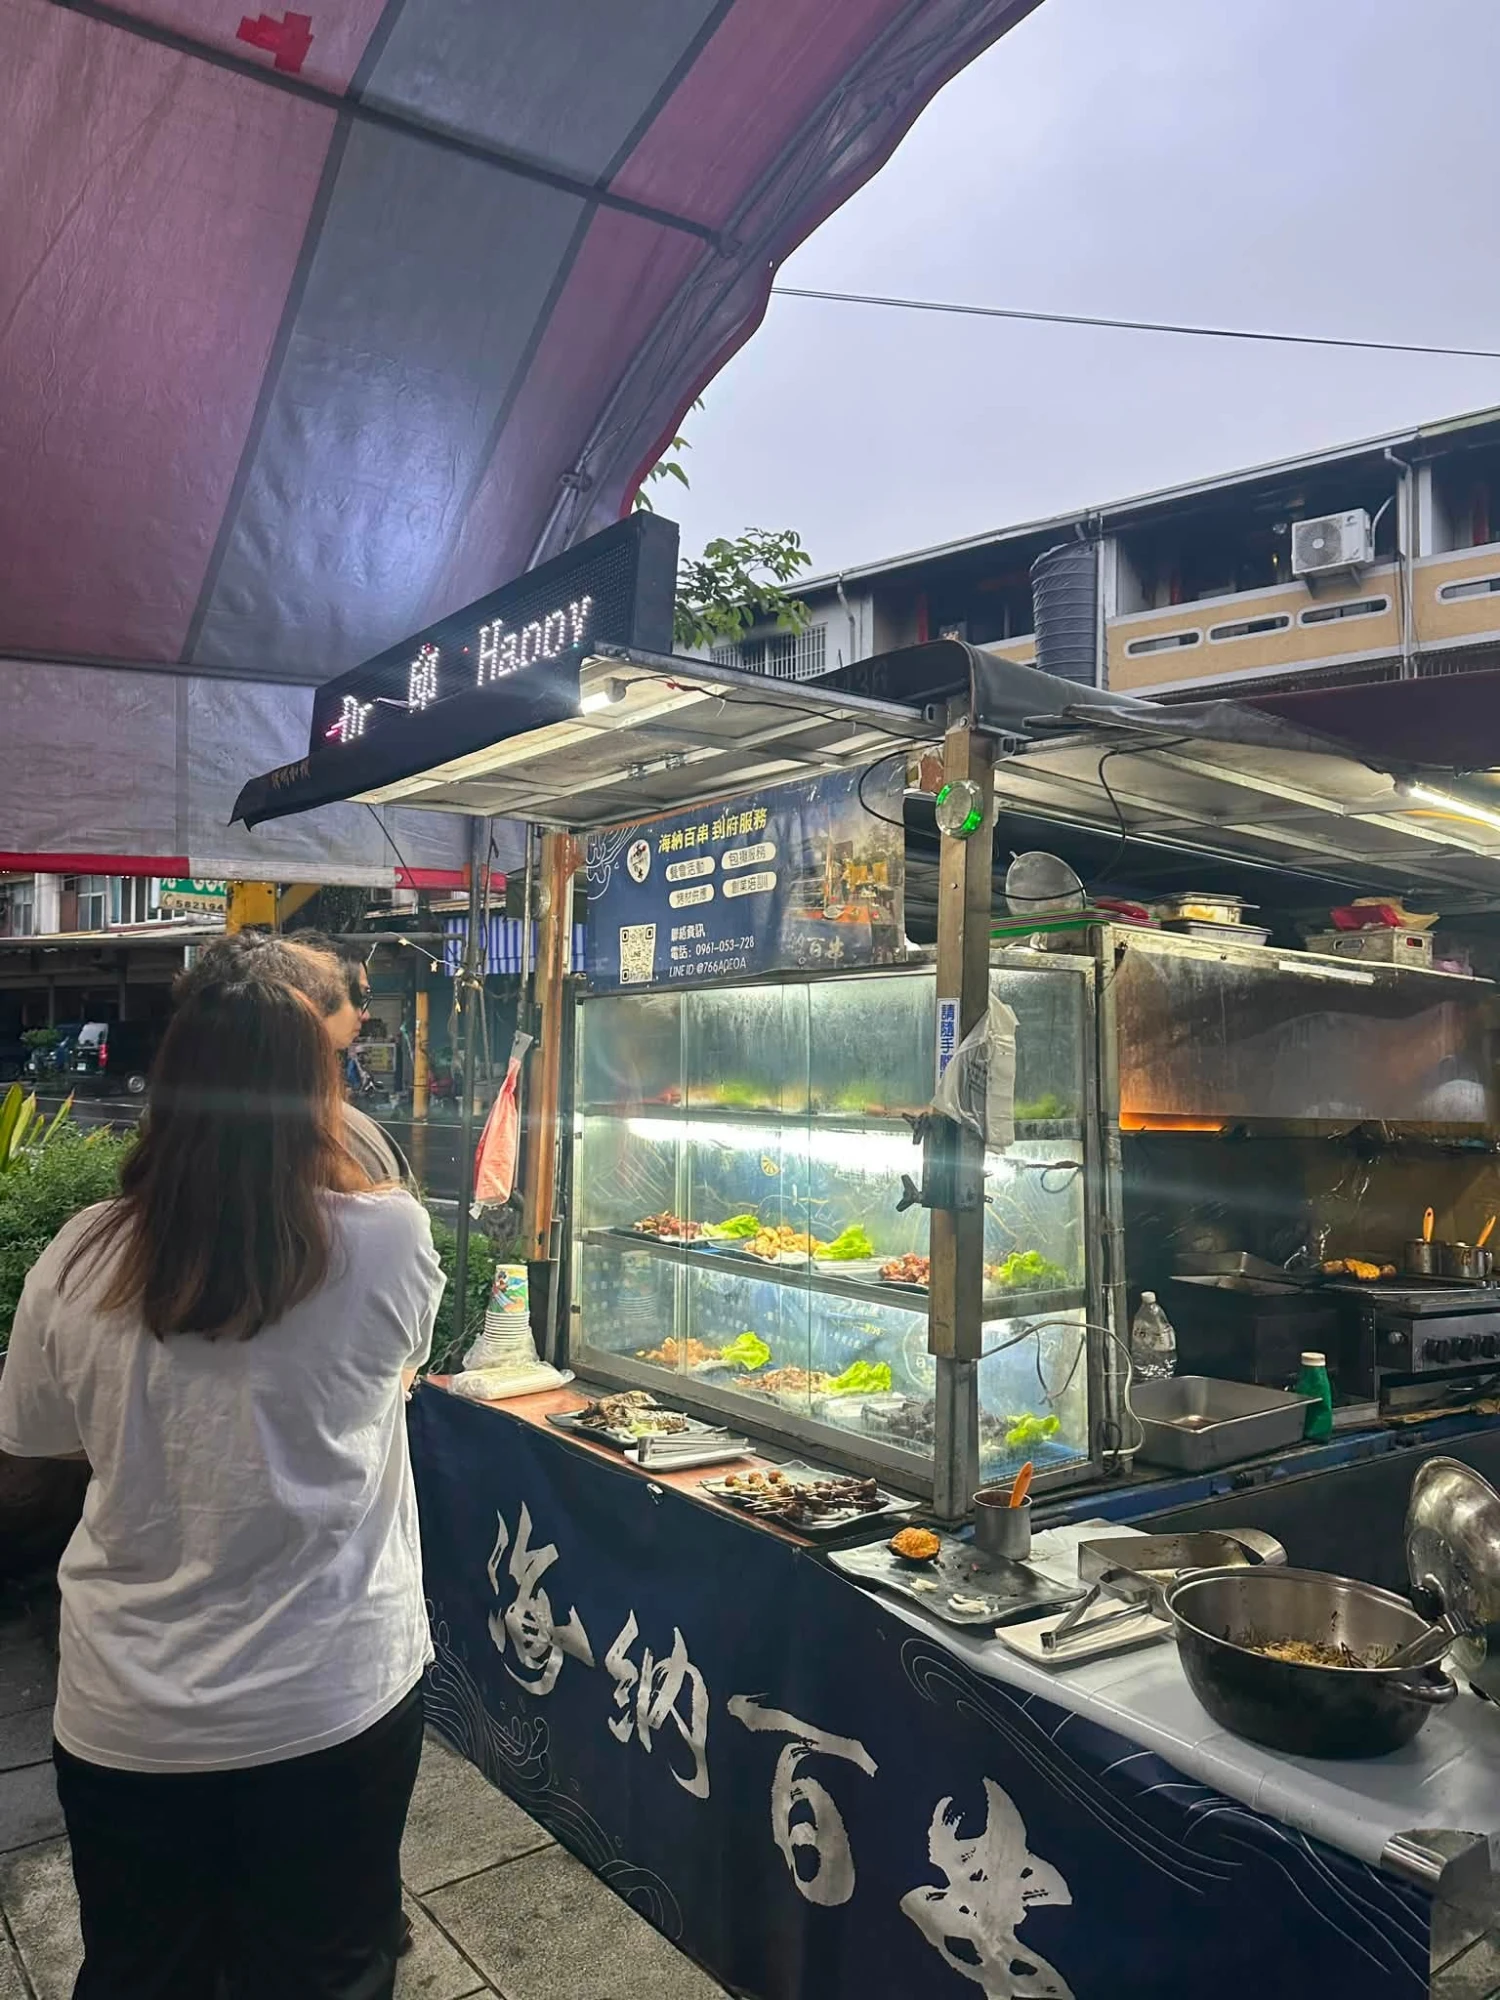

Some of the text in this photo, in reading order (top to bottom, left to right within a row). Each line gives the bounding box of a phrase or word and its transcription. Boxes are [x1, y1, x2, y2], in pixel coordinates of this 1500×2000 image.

[658, 807, 768, 854] 海納百串 到府服務
